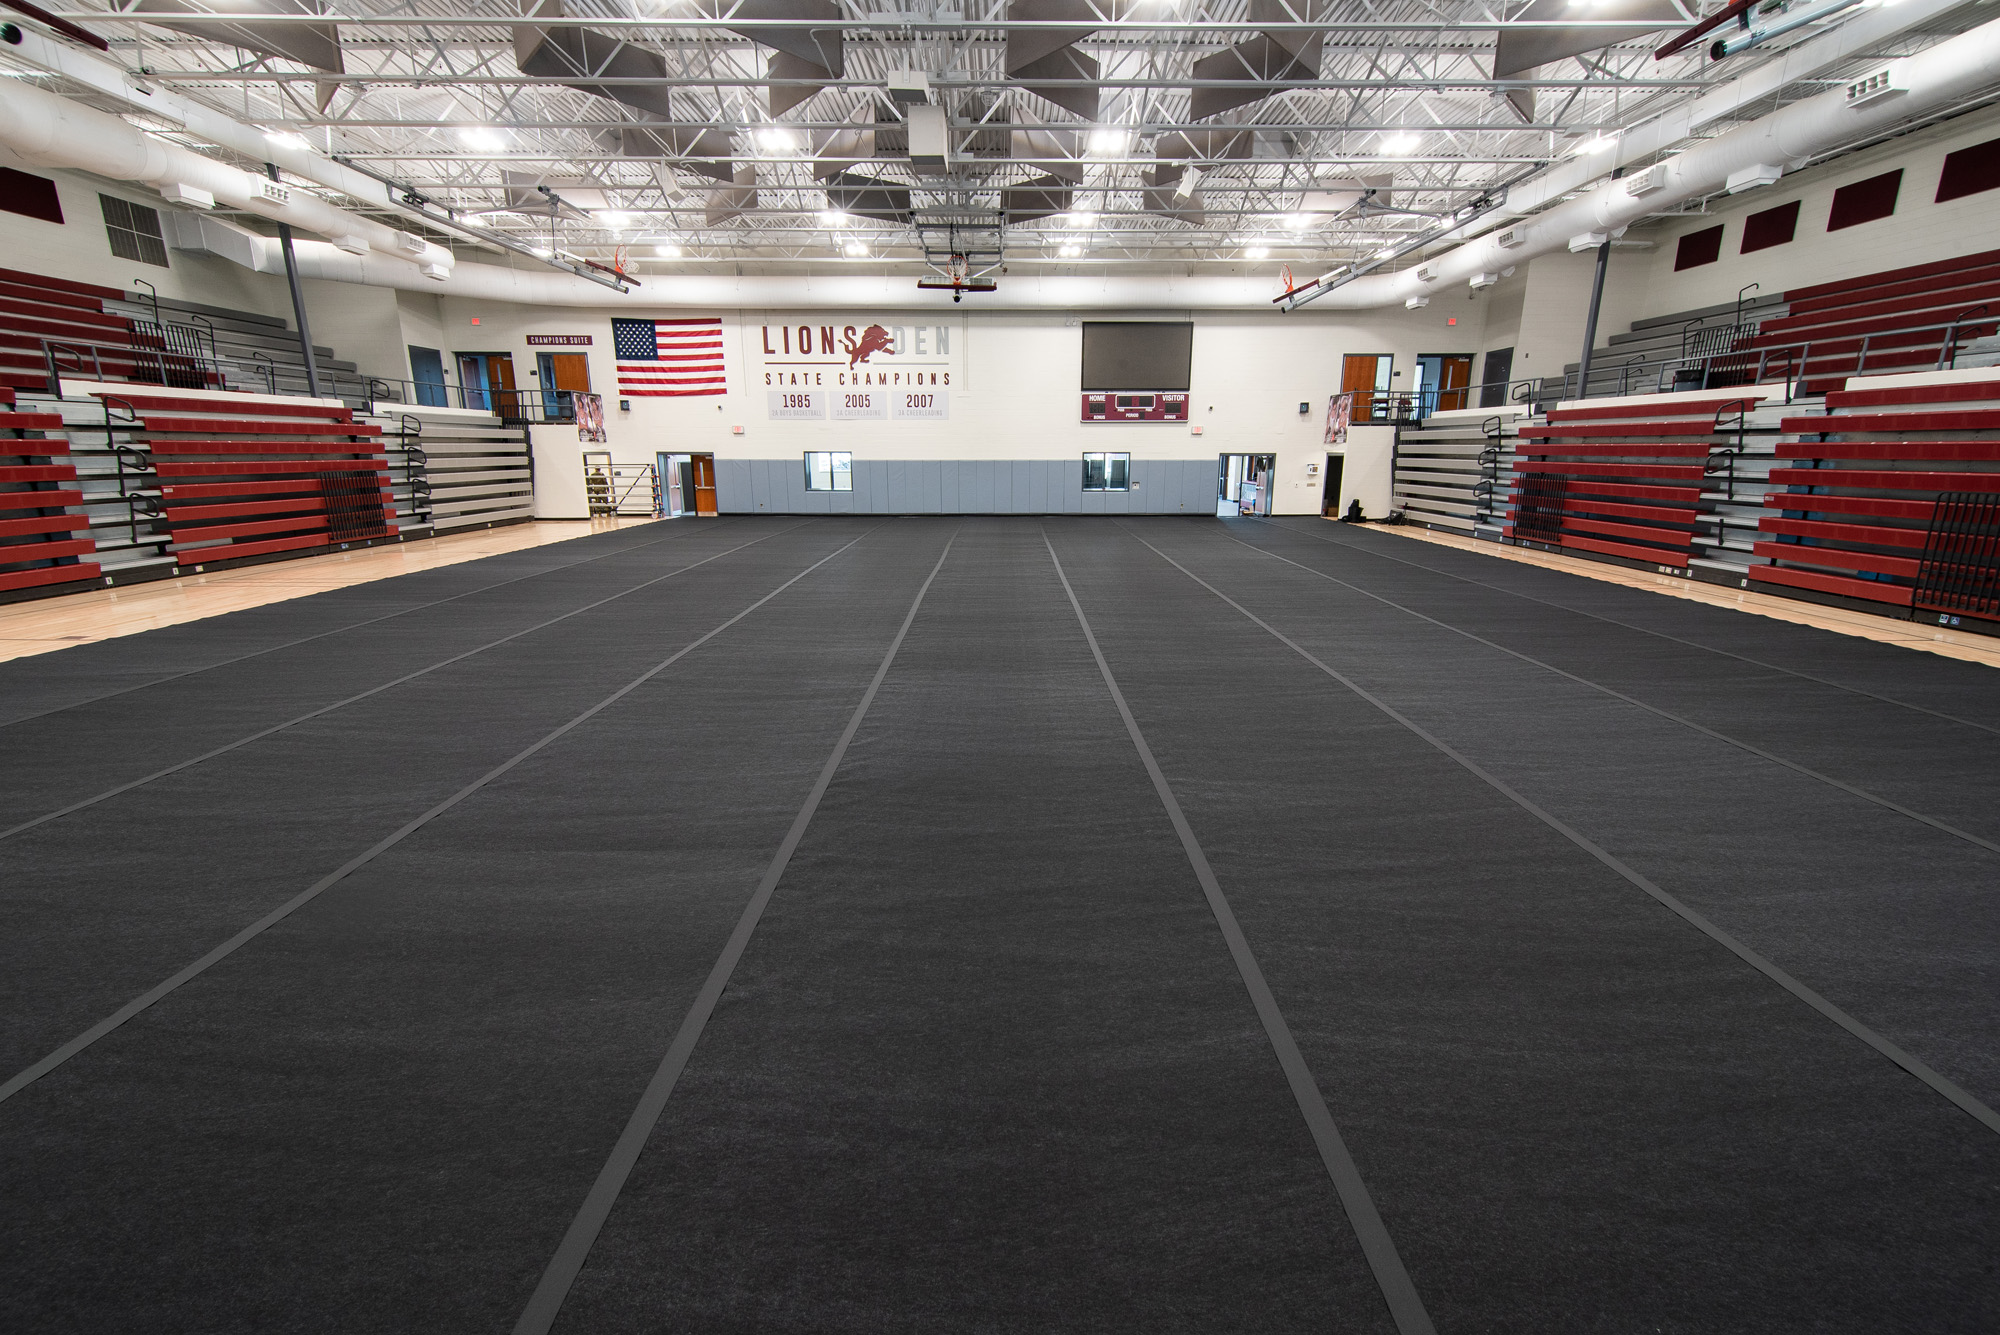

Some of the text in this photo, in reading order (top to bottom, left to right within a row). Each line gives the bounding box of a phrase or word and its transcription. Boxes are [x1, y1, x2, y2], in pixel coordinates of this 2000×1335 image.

[530, 336, 588, 344] CHAMPIONS SUITE
[762, 326, 950, 355] LIONS DEN
[765, 373, 950, 386] STATE CHAMPIONS
[783, 394, 811, 408] 1985
[845, 394, 871, 408] 2005
[906, 394, 934, 408] 2007
[1162, 394, 1185, 402] VISITOR
